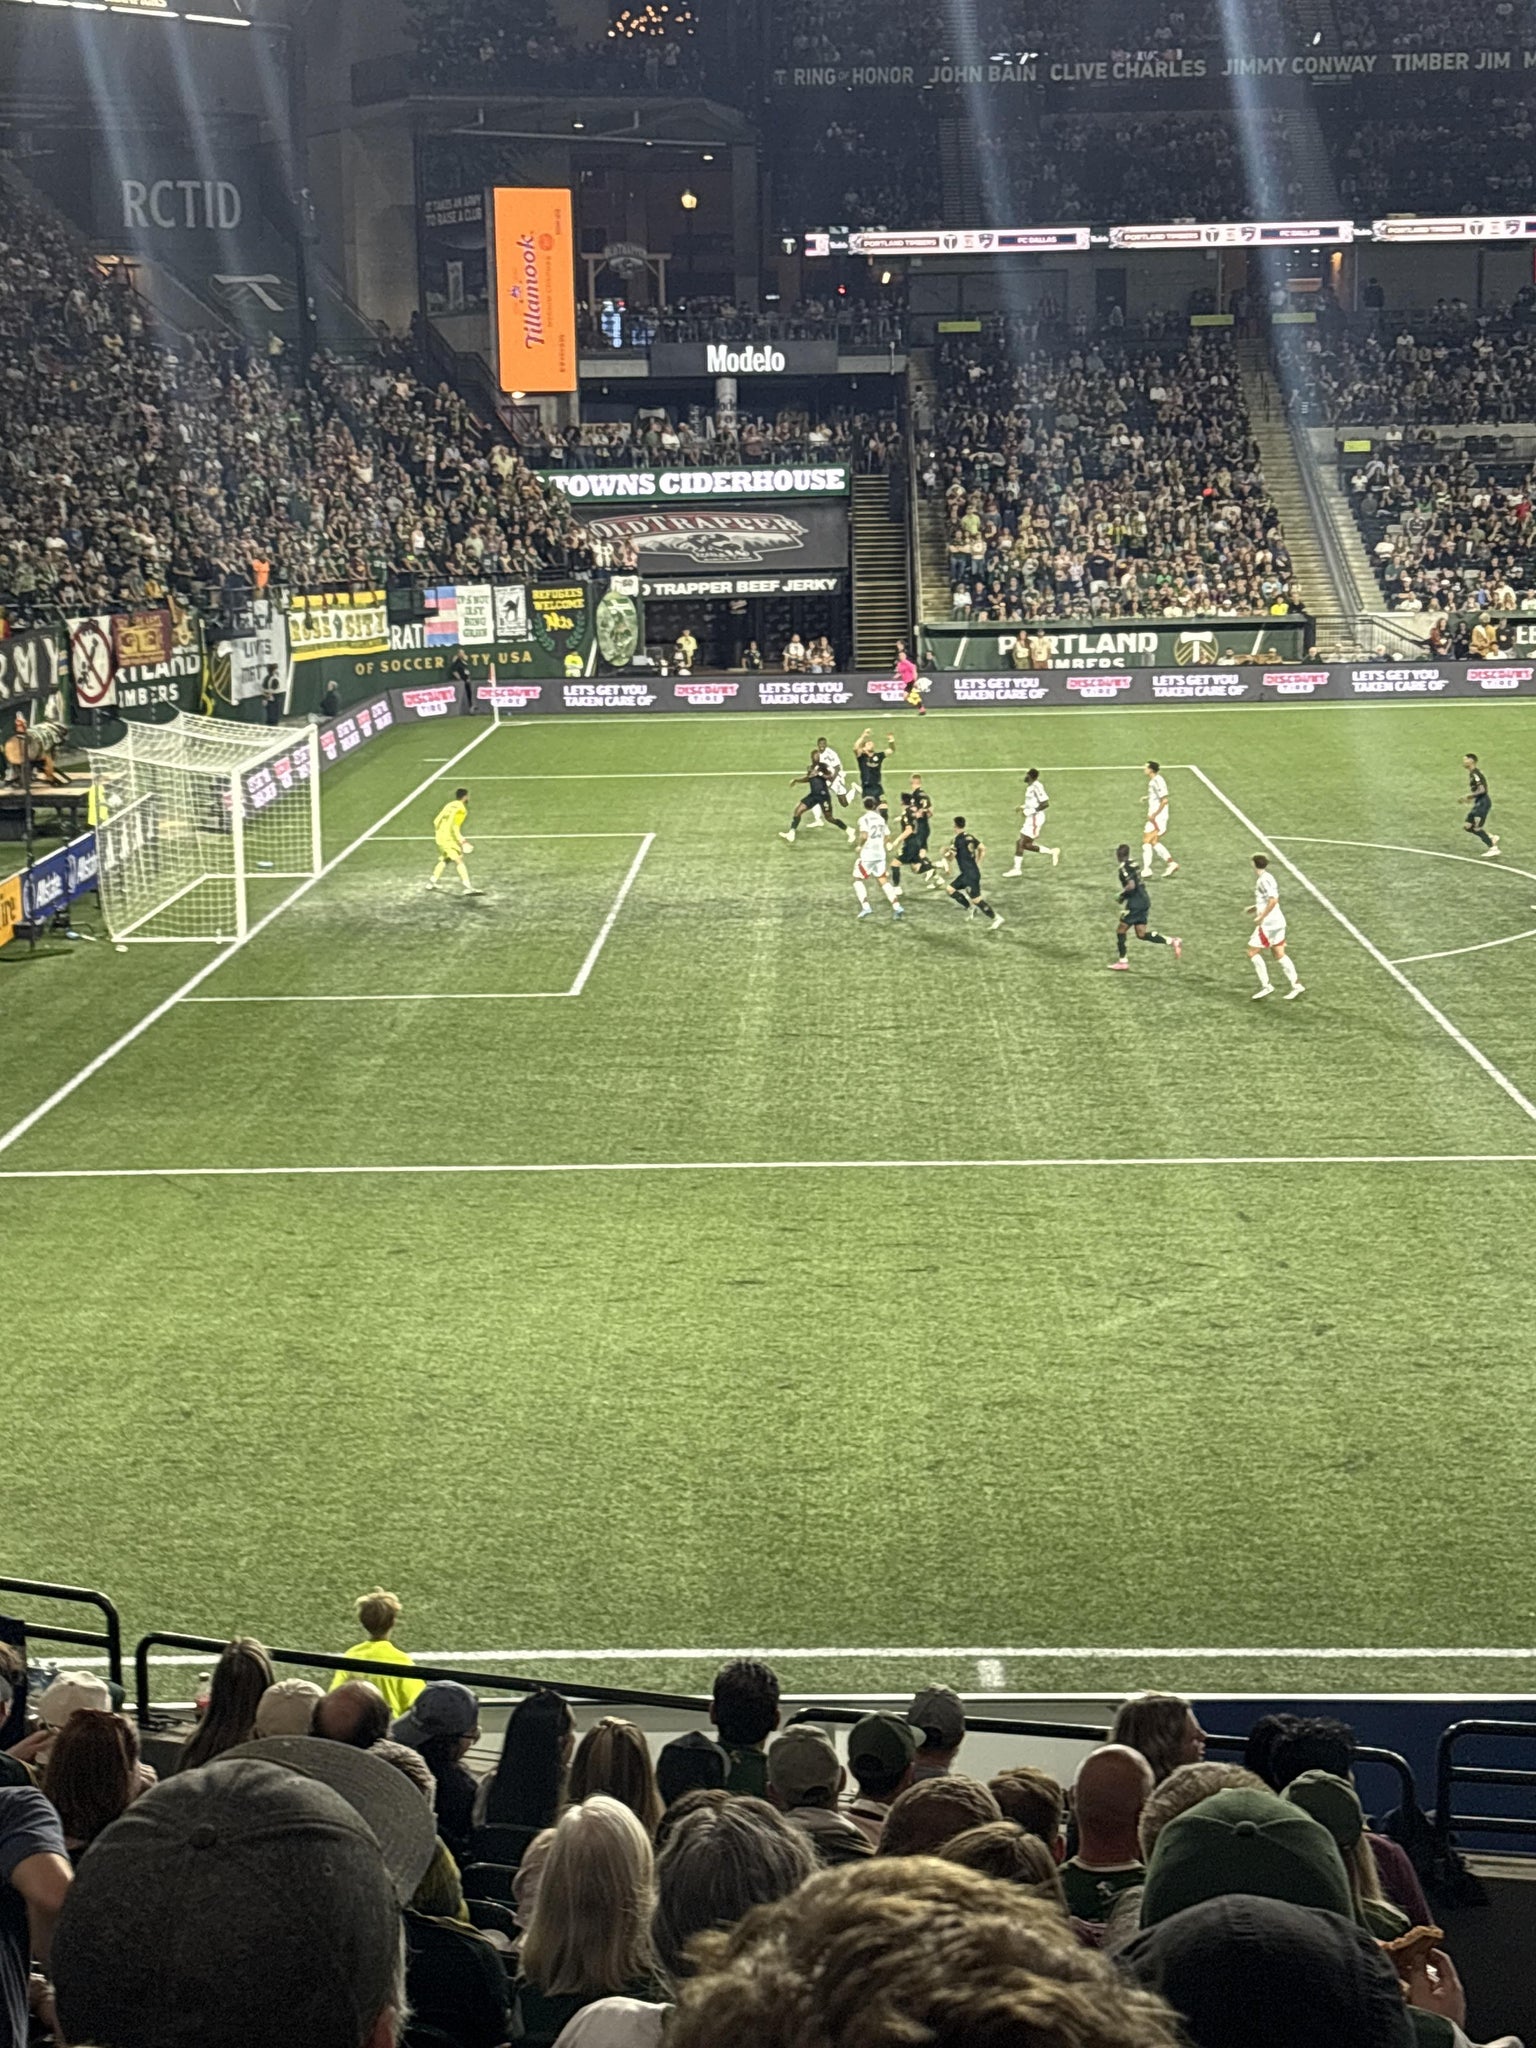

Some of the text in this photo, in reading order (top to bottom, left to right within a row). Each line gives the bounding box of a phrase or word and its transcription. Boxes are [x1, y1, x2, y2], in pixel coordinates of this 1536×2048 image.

[1050, 59, 1206, 80] CLIVE CHARLES
[1221, 55, 1377, 76] JIMMY CONWAY
[1392, 52, 1469, 71] TIMBER
[1474, 51, 1510, 69] JIM
[794, 68, 836, 86] RING
[852, 66, 914, 85] HONOR
[929, 65, 1037, 83] JOHN BAIN
[122, 179, 241, 229] RCTID
[516, 233, 545, 349] Tillamook
[707, 344, 785, 372] Modelo
[548, 468, 845, 497] TOWNS CIDERHOUSE
[589, 515, 800, 538] OLD TRAPPER
[532, 587, 583, 599] REFUGEES
[653, 581, 733, 596] TRAPPER
[736, 580, 780, 593] BEEF
[782, 578, 837, 592] JERKY
[533, 598, 585, 610] WELCOME
[998, 632, 1159, 656] PRTLAND
[355, 662, 374, 676] OF
[380, 656, 445, 673] SOCCER
[498, 650, 532, 664] USA
[987, 677, 1012, 689] GET
[1012, 677, 1039, 688] YOU
[1186, 674, 1210, 686] GET
[1210, 674, 1239, 685] YOU
[1385, 670, 1411, 681] GET
[1411, 669, 1439, 680] YOU
[596, 684, 620, 696] GET
[620, 684, 647, 696] YOU
[792, 682, 816, 693] GET
[816, 682, 843, 692] YOU
[954, 688, 1049, 700] TAKEN CARE OF
[1152, 685, 1248, 697] TAKEN CARE OF
[1352, 680, 1449, 692] TAKEN CARE OF
[118, 683, 180, 708] IMBERS
[563, 695, 657, 706] TAKEN CARE OF
[759, 692, 853, 704] TAKEN CARE OF
